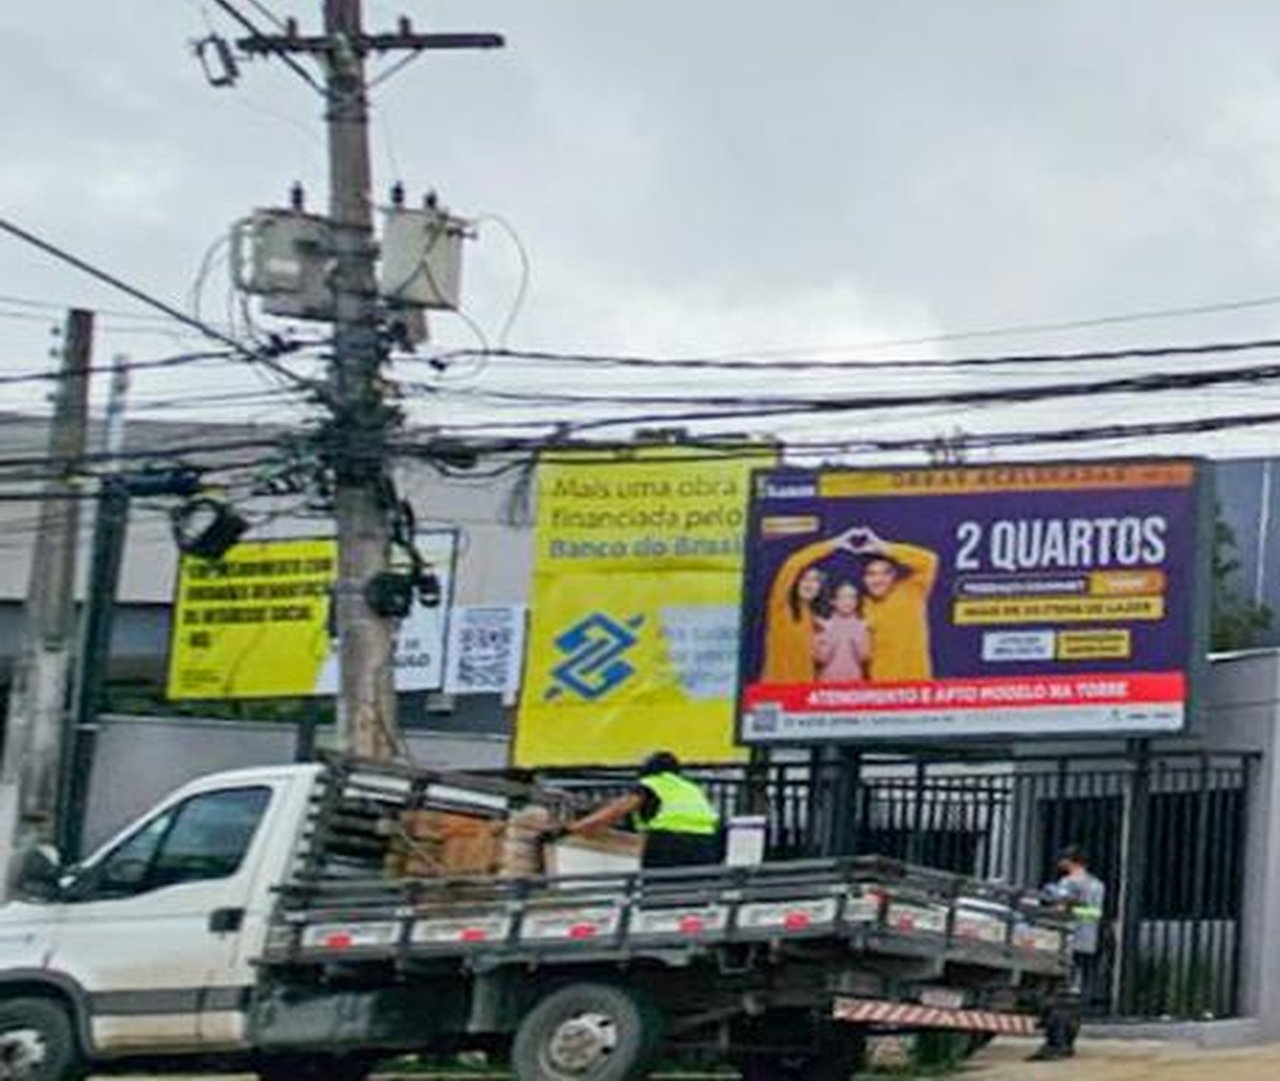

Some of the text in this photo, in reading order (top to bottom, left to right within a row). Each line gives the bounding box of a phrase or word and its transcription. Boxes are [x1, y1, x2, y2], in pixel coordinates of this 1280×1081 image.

[617, 482, 671, 498] uma
[678, 474, 738, 496] obra
[552, 505, 678, 528] financiada
[684, 504, 743, 531] pelo
[633, 536, 668, 557] do
[955, 516, 1167, 570] 2 QUARTOS
